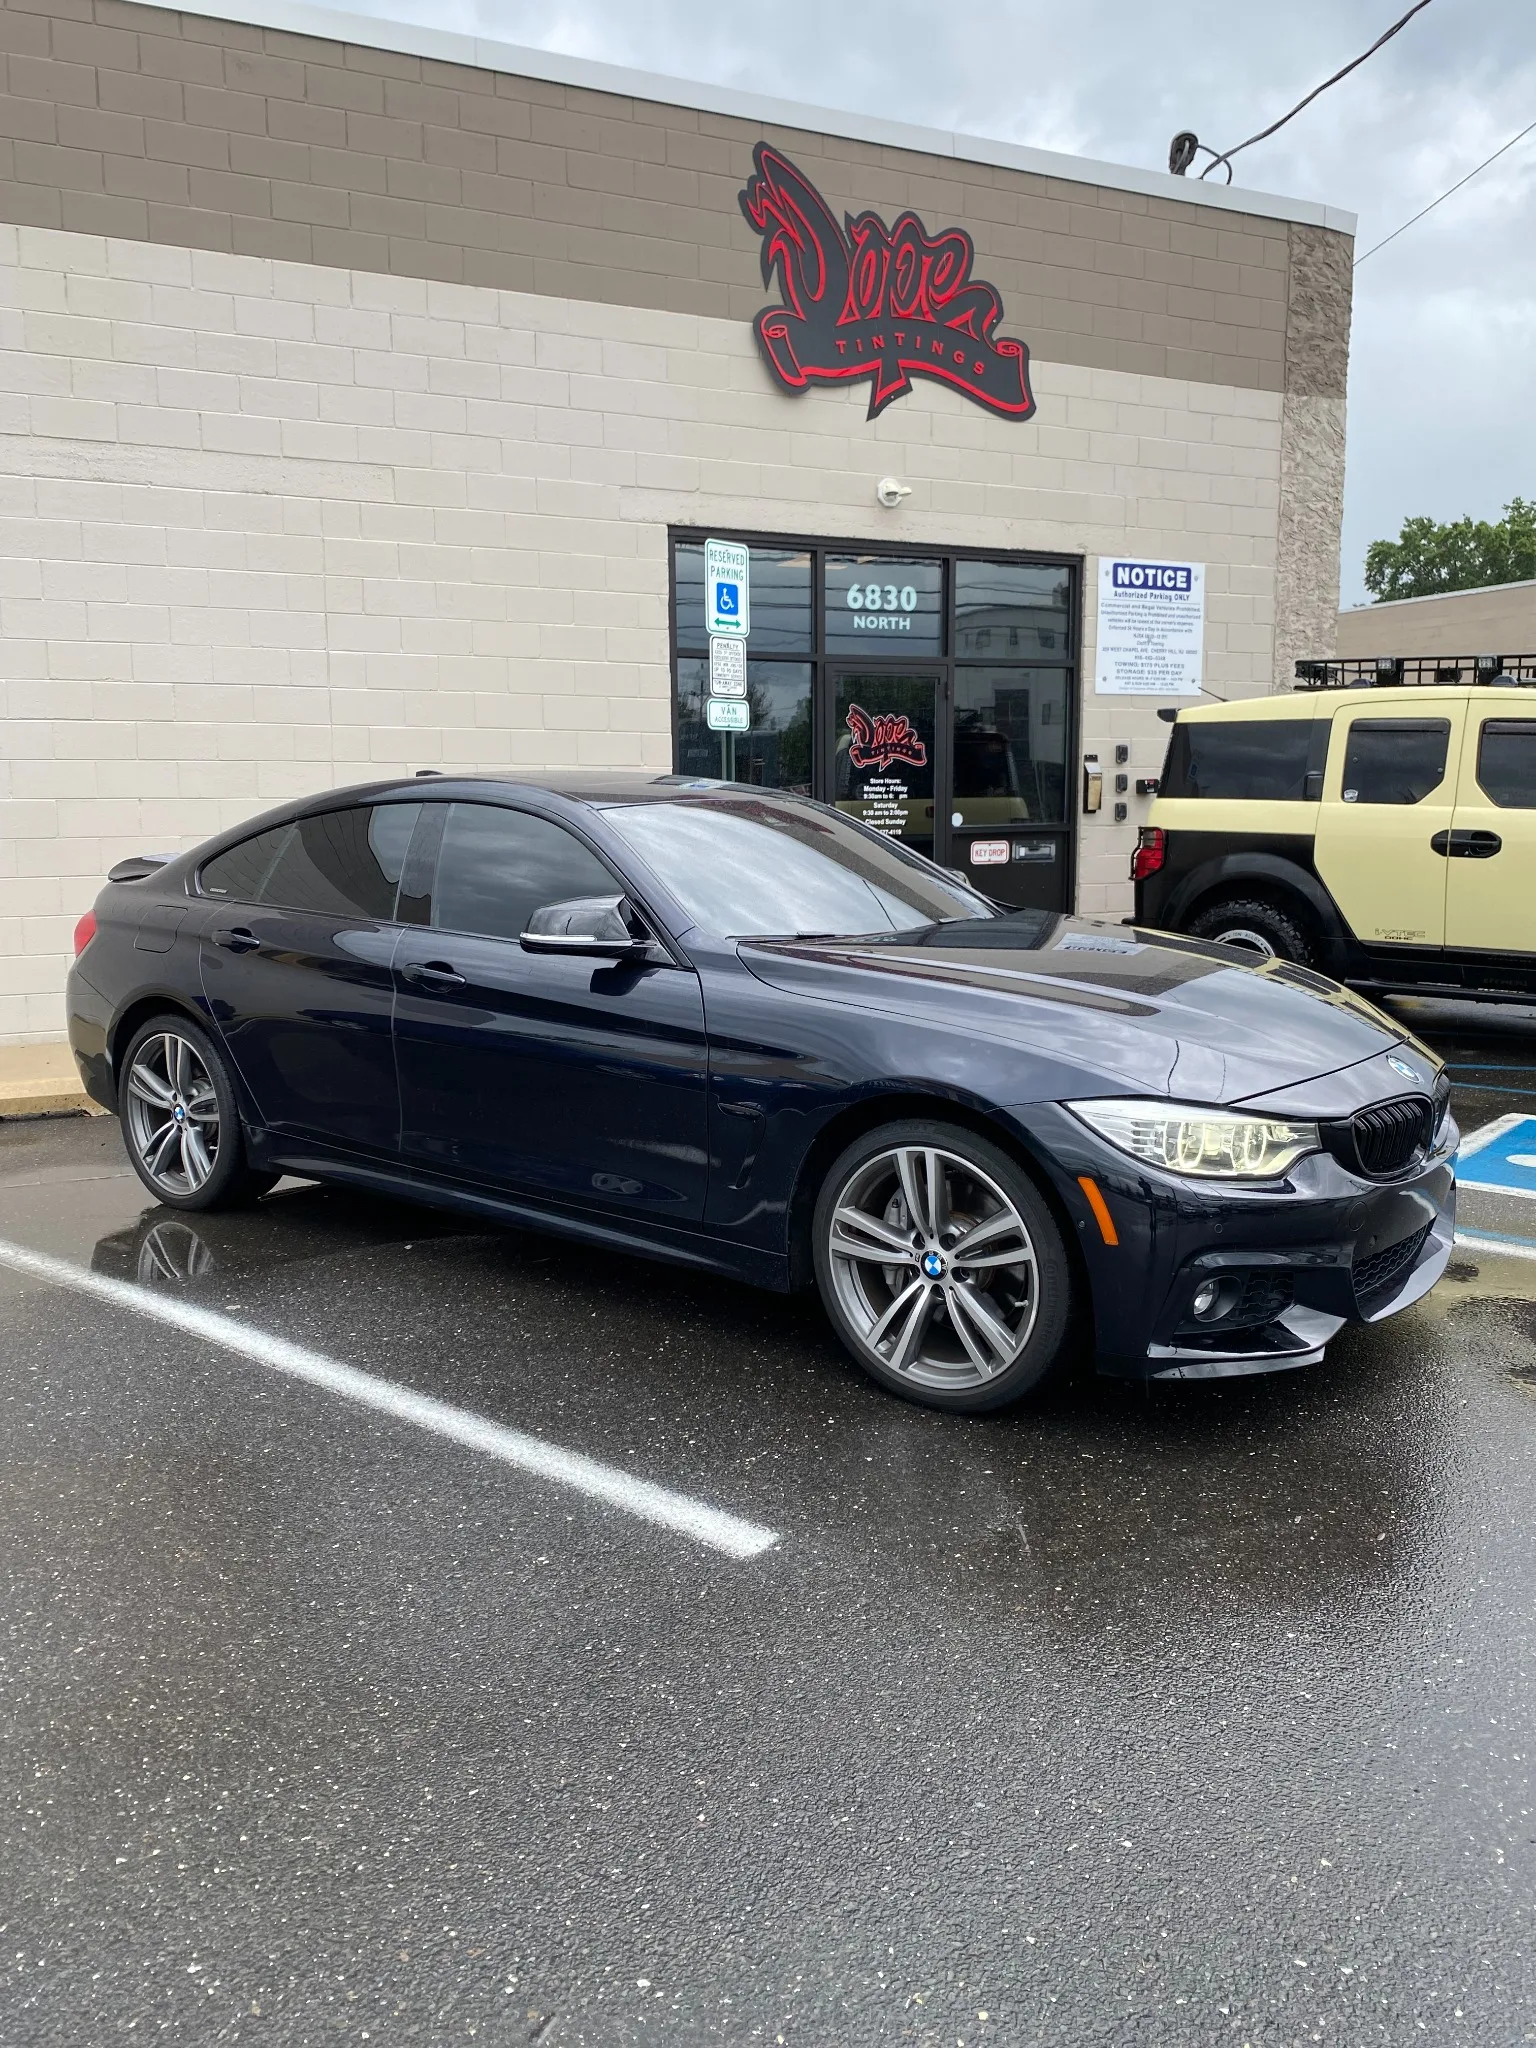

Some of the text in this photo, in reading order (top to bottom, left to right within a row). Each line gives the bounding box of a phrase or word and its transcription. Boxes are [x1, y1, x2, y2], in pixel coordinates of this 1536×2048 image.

[835, 332, 986, 375] TINTINGS
[709, 550, 744, 566] RESERVED
[710, 566, 744, 581] PARKING
[1117, 566, 1188, 588] NOTICE
[846, 584, 917, 612] 6830
[1114, 590, 1148, 599] Authorized
[1150, 591, 1172, 602] Parking
[854, 616, 911, 630] NORTH
[721, 706, 737, 715] VAN
[871, 746, 912, 756] TINTINGS
[1245, 934, 1260, 942] ALLOY
